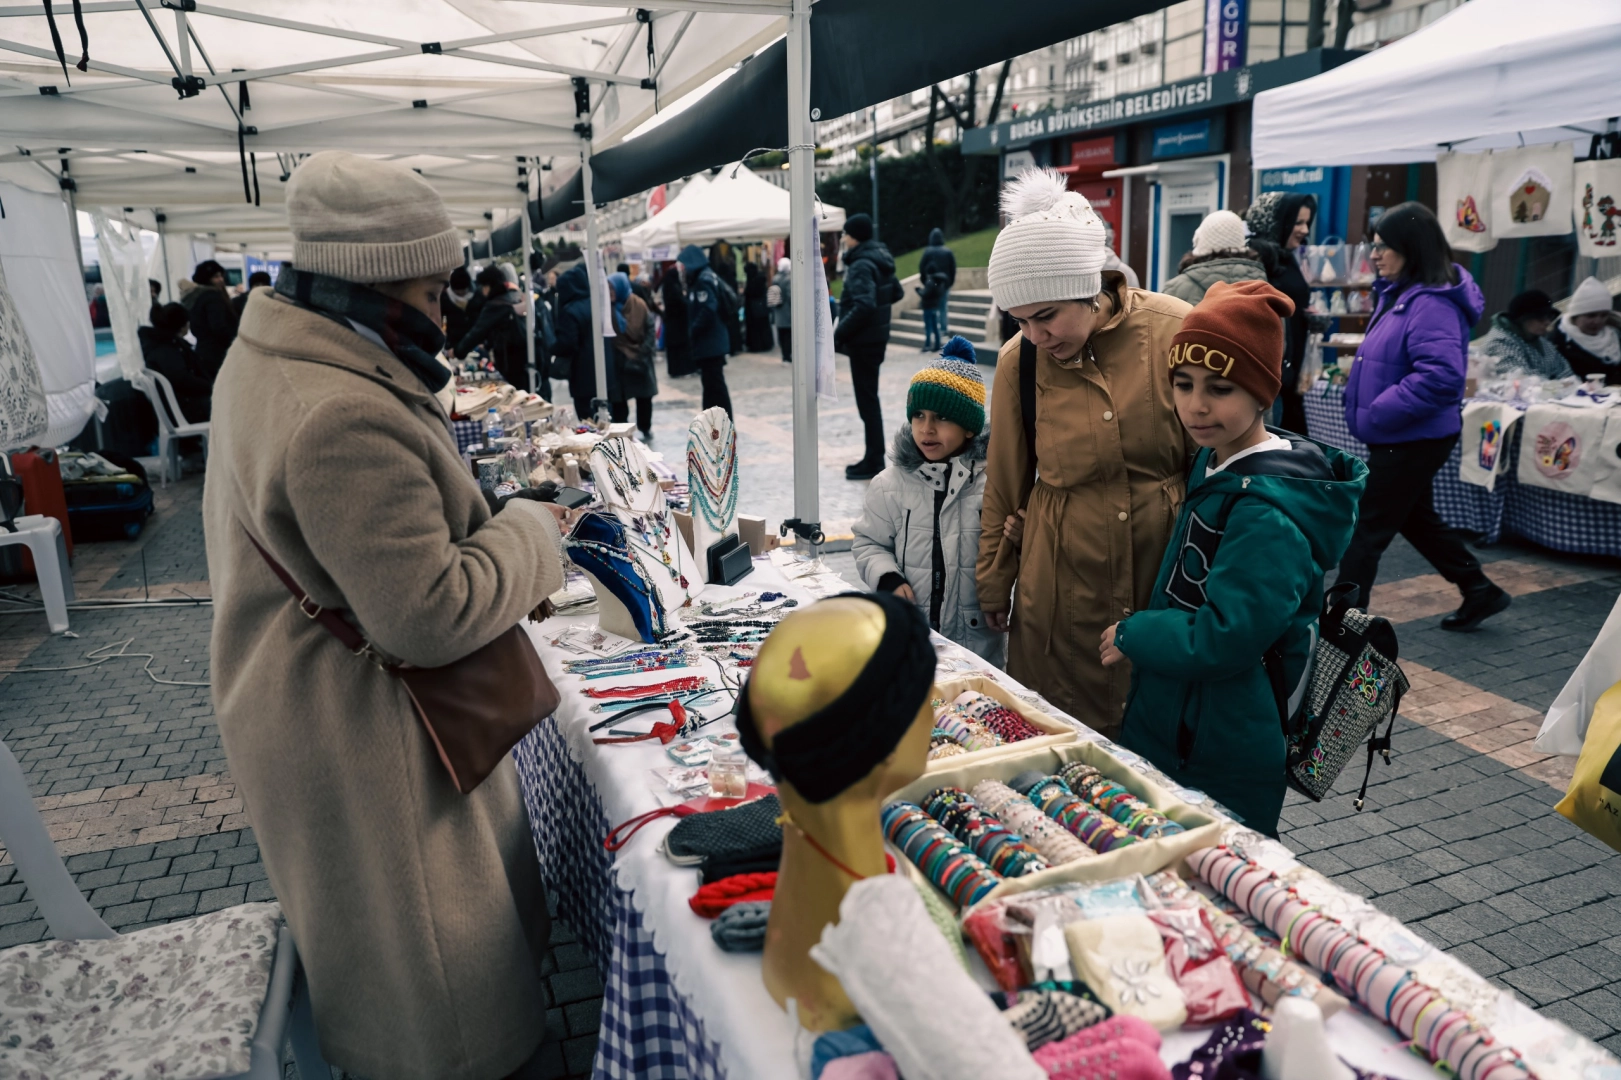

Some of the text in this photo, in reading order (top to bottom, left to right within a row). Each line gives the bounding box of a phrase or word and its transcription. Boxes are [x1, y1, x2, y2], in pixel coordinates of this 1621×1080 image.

[1010, 77, 1213, 141] BURSA BÜYÜKŞEHİR BELEDİYESİ
[1168, 342, 1235, 377] GUCCI
